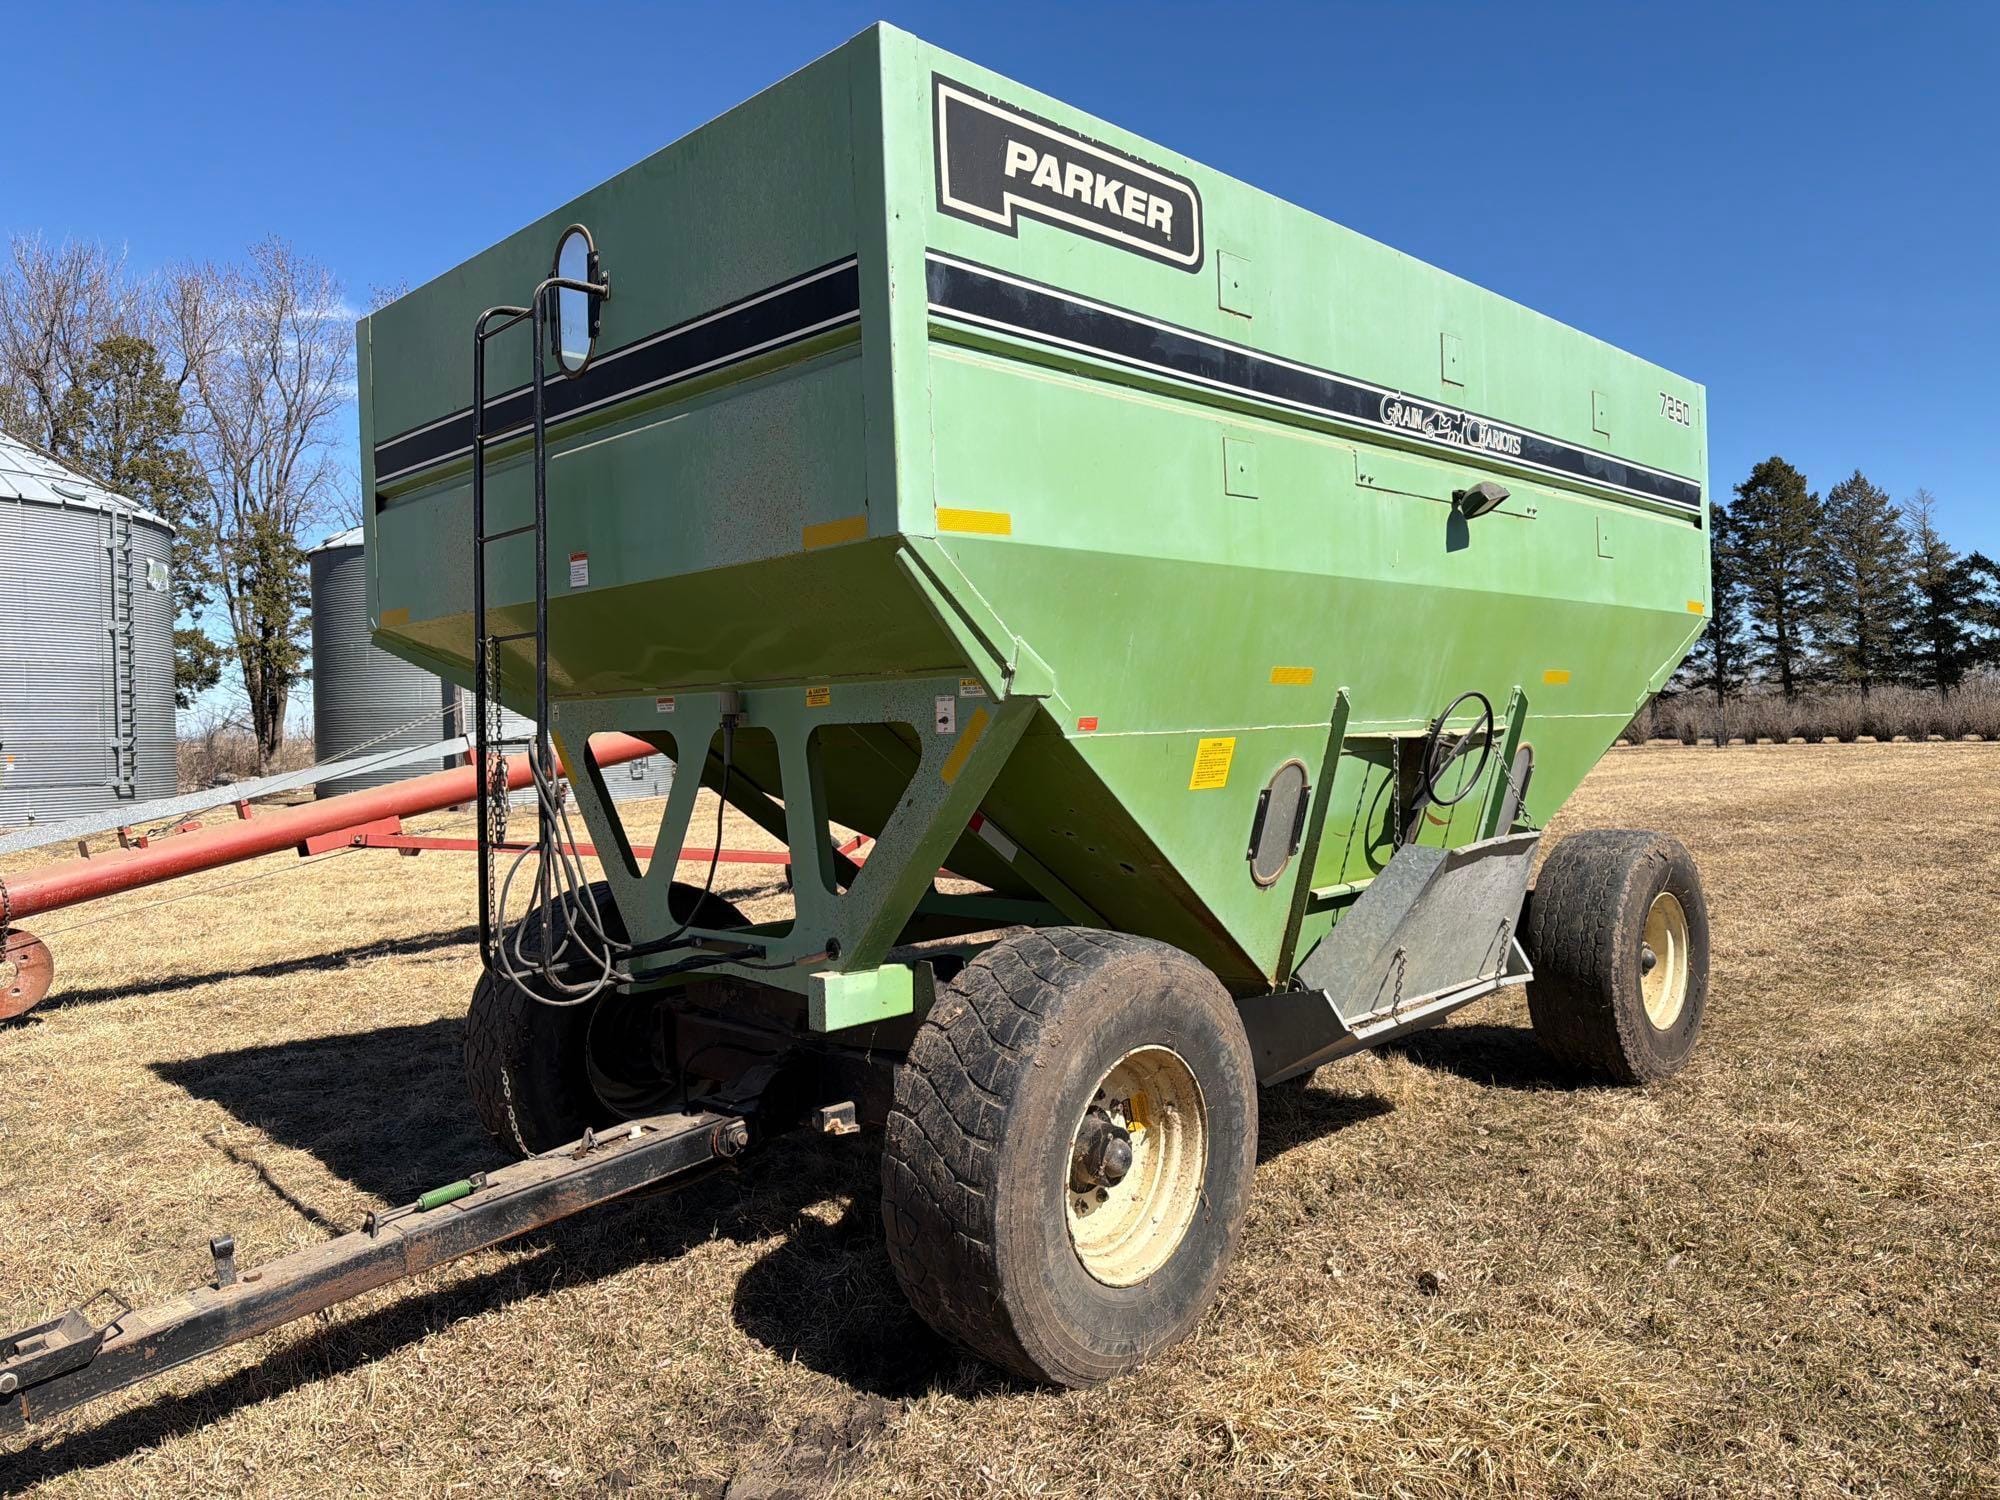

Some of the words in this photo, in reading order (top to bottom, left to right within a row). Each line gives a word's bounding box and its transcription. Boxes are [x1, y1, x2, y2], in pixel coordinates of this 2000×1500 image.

[1004, 139, 1174, 235] PARKER
[1380, 391, 1424, 430] GRAIN
[1467, 419, 1522, 456] CHARIOTS
[1659, 391, 1690, 427] 7250
